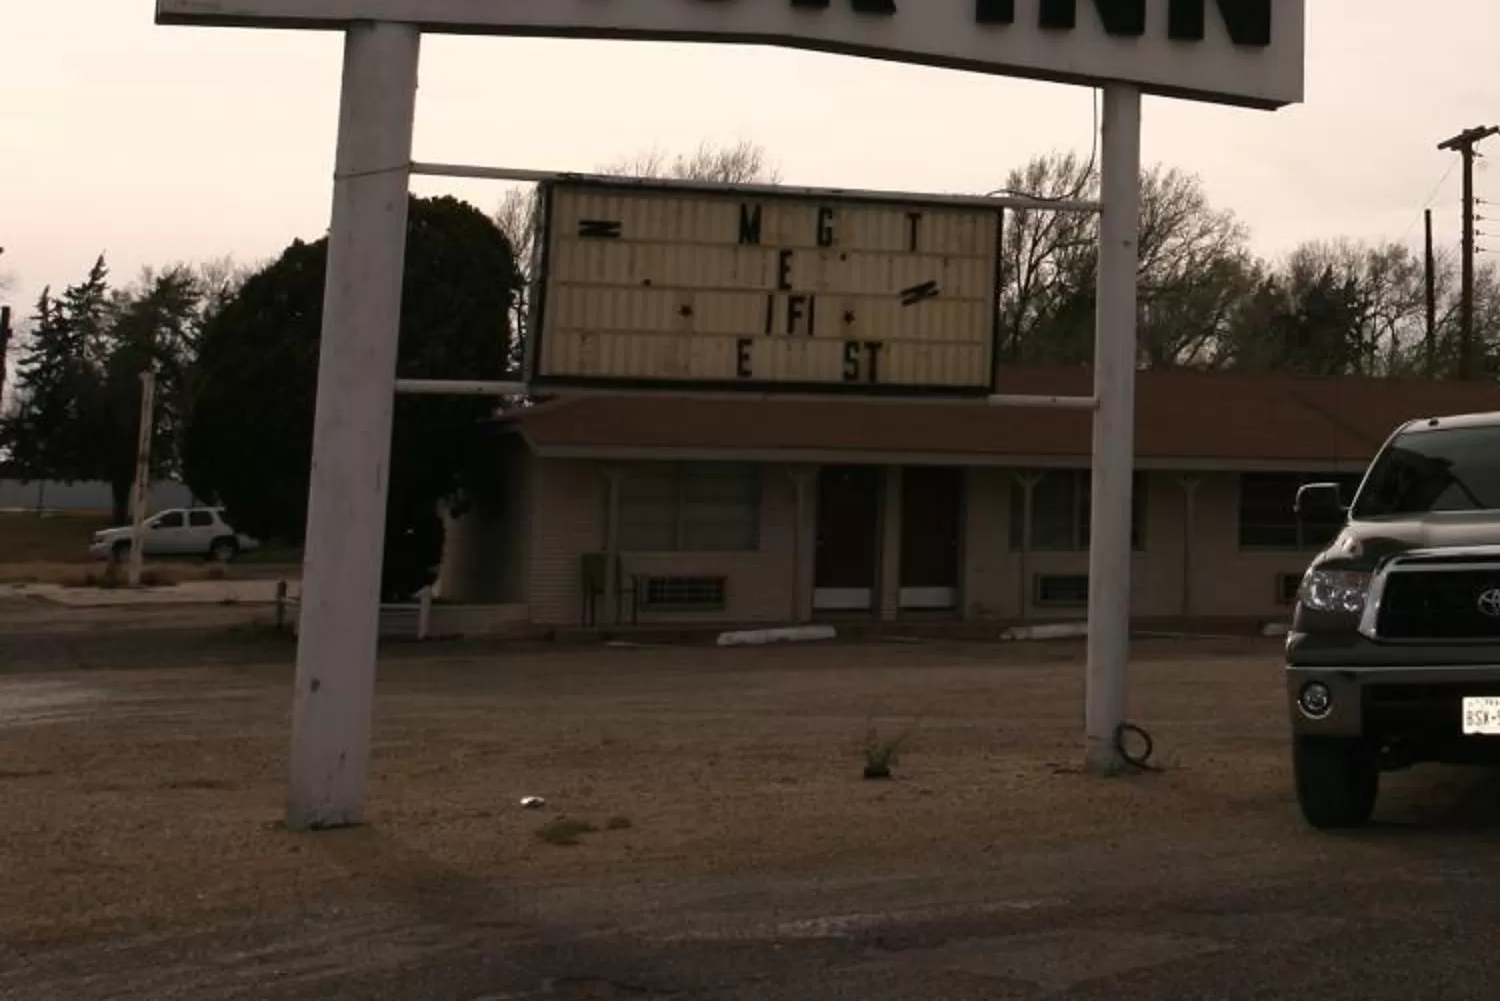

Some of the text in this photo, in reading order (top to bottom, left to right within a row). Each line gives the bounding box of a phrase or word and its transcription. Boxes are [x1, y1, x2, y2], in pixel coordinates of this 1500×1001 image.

[817, 206, 833, 248] G
[907, 212, 922, 252] T
[778, 249, 794, 292] E
[736, 338, 884, 383] E ST
